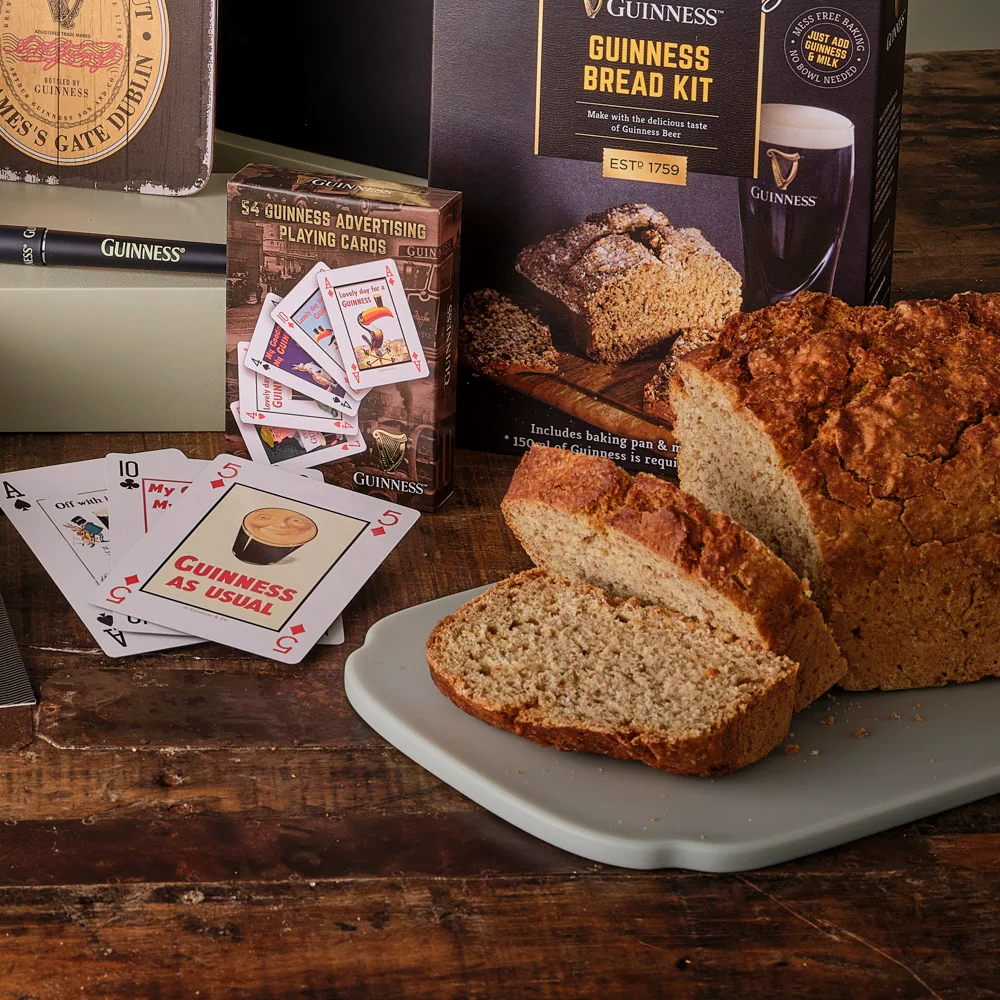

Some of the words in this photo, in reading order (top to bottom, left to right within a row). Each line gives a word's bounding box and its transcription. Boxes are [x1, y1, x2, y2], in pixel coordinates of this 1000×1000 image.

[792, 14, 814, 37] MESS
[816, 12, 841, 22] FREE
[842, 18, 865, 52] BAKING
[808, 30, 830, 44] JUST
[831, 36, 850, 49] ADD
[589, 34, 710, 72] GUINNESS
[804, 40, 848, 60] GUINNESS
[789, 50, 800, 63] NO
[796, 63, 821, 83] BOWL
[824, 66, 857, 84] NEEDED
[808, 52, 814, 61] &
[816, 54, 839, 68] MILK
[34, 84, 89, 98] GUINNESS
[44, 78, 70, 86] BOTTLED
[584, 65, 664, 98] BREAD
[674, 74, 713, 103] KIT
[54, 125, 110, 152] GATE
[106, 52, 154, 131] DUBLIN
[588, 110, 609, 120] Make
[611, 113, 630, 122] with
[632, 115, 645, 124] the
[648, 117, 685, 128] delicious
[687, 121, 708, 130] taste
[611, 124, 621, 132] of
[622, 126, 660, 136] Guinness
[662, 130, 682, 139] Beer
[648, 162, 680, 176] 1759
[311, 178, 392, 195] GUINNESS
[750, 186, 816, 207] GUINNESS
[241, 200, 259, 217] 54
[265, 203, 331, 227] GUINNESS
[336, 213, 426, 240] ADVERTISING
[279, 226, 336, 248] PLAYING
[341, 234, 387, 255] CARDS
[386, 265, 394, 277] A
[324, 277, 332, 289] A
[339, 290, 358, 298] Lovely
[342, 297, 372, 308] GUINNESS
[277, 312, 289, 323] 10
[251, 358, 262, 367] 4
[265, 348, 275, 359] My
[273, 356, 284, 367] My
[413, 360, 421, 372] A
[352, 372, 360, 384] A
[263, 390, 271, 410] Lovely
[340, 401, 352, 409] 4
[349, 440, 361, 448] 7
[530, 424, 582, 440] Includes
[586, 430, 627, 449] baking
[631, 439, 653, 455] pan
[657, 440, 668, 451] &
[570, 444, 627, 461] Guinness
[630, 452, 641, 462] is
[119, 460, 139, 478] 10
[217, 462, 242, 479] 5
[2, 480, 25, 499] A
[149, 483, 175, 497] My
[55, 501, 75, 510] Off
[77, 498, 102, 508] with
[377, 508, 402, 526] 5
[174, 554, 298, 603] GUINNESS
[106, 586, 132, 605] 5
[165, 575, 198, 594] AS
[205, 584, 275, 616] USUAL
[103, 628, 127, 648] A
[273, 635, 298, 654] 5
